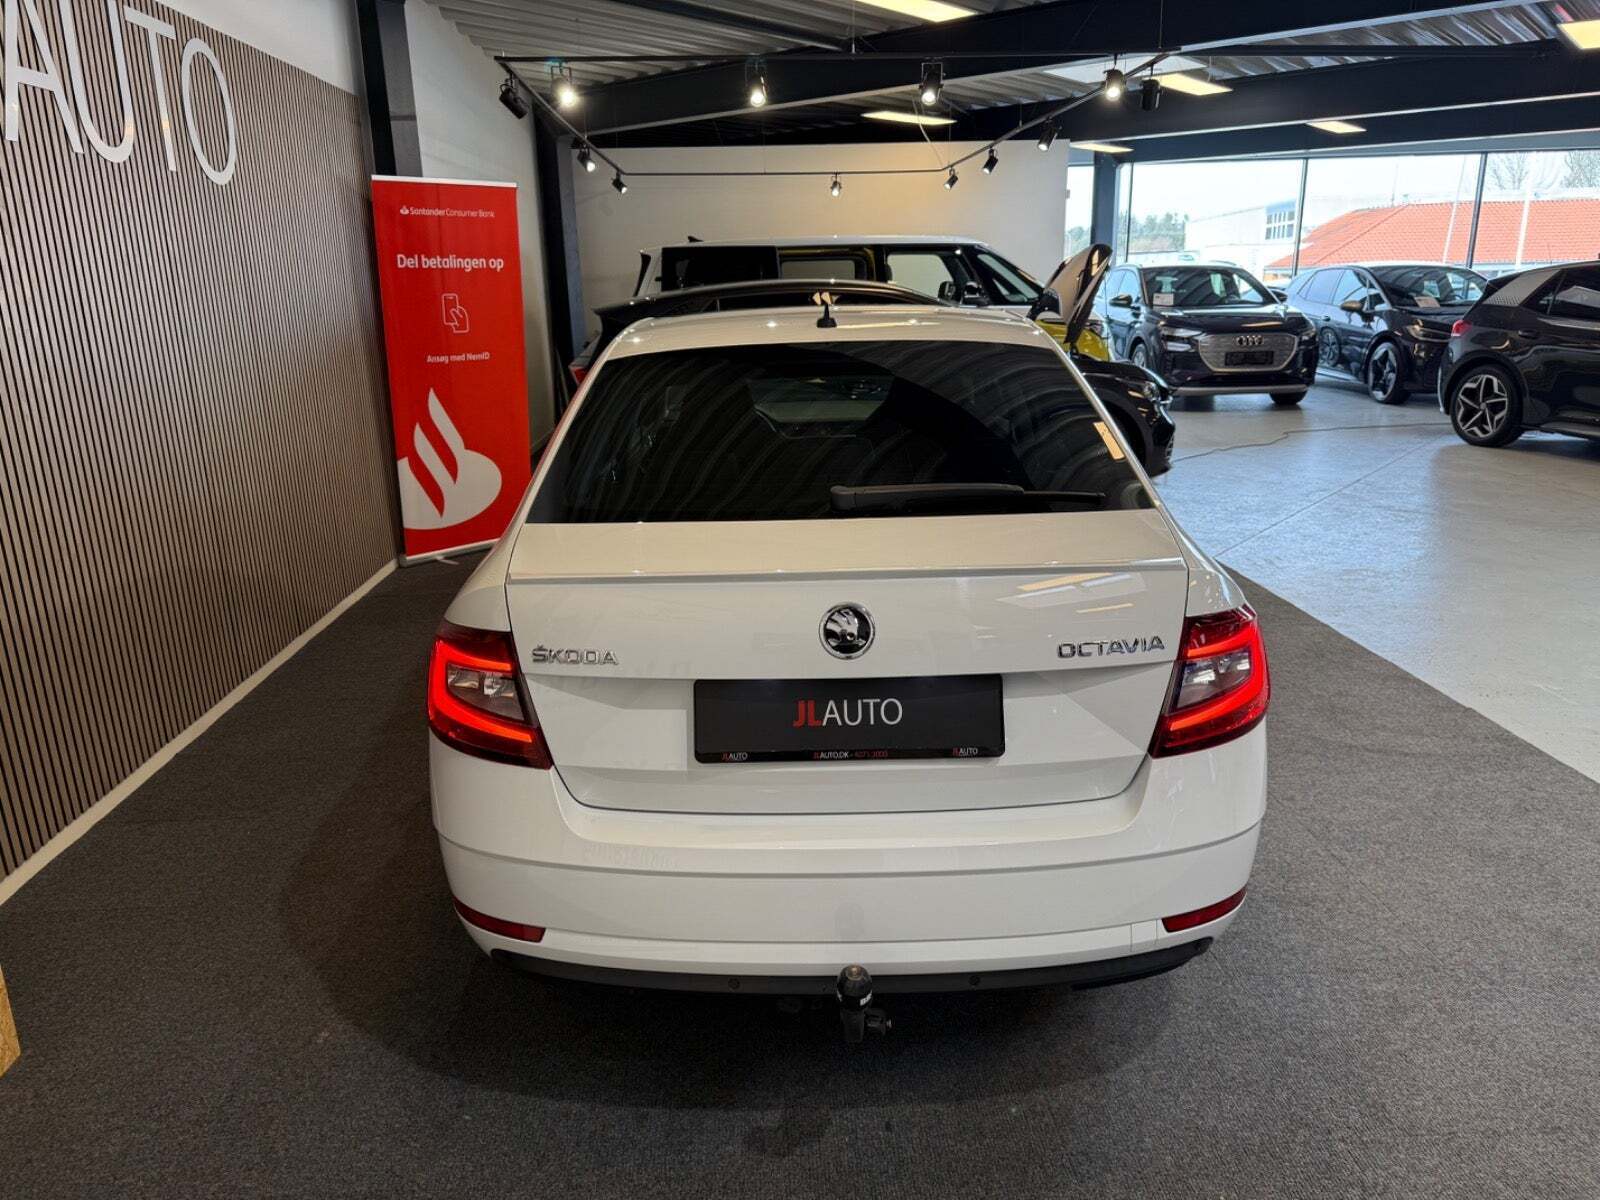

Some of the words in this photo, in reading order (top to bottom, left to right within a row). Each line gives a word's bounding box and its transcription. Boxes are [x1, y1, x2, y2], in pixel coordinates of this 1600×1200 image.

[5, 0, 236, 186] AUTO
[397, 253, 419, 269] Del
[421, 254, 487, 272] betalingen
[488, 258, 504, 272] op
[426, 354, 449, 365] Ansøg
[449, 353, 466, 362] med
[466, 351, 490, 361] NemID
[531, 644, 619, 666] ŠKODA
[1057, 635, 1165, 659] OCTAVIA
